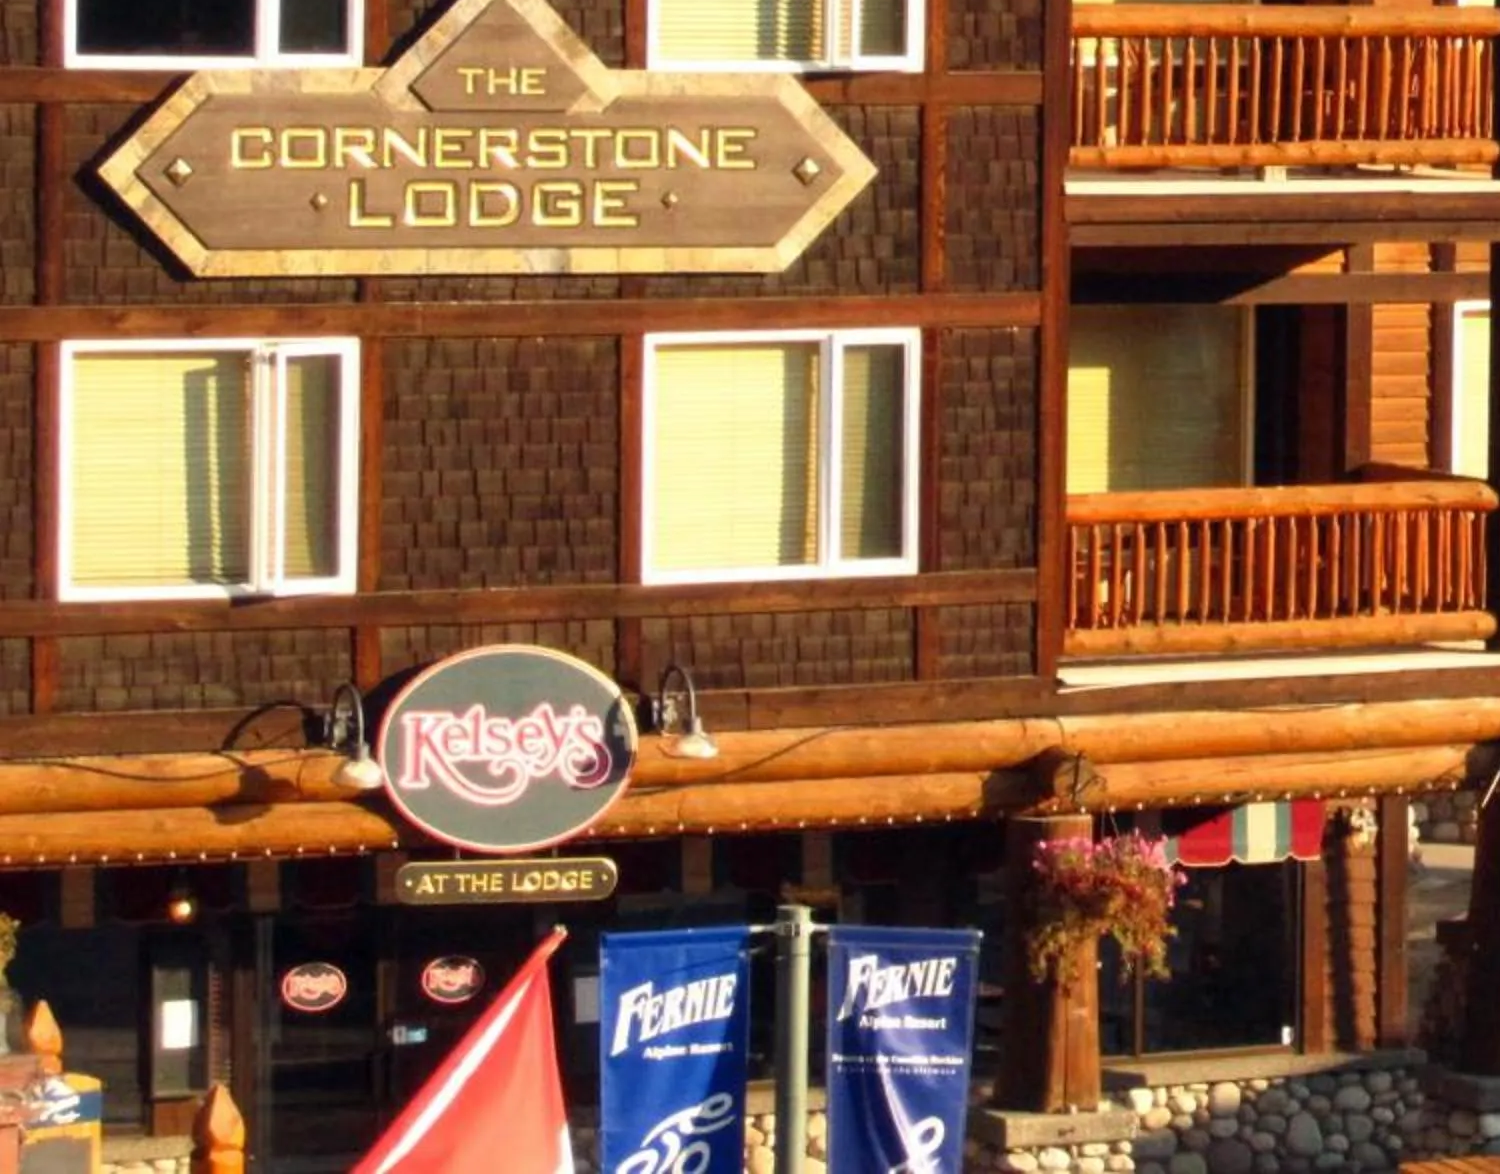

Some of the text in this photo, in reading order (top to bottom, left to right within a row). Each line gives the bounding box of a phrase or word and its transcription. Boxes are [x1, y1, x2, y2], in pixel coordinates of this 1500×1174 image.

[457, 67, 547, 95] THE
[231, 126, 757, 169] CORNERSTONE
[348, 179, 639, 228] LODGE
[399, 702, 612, 805] Kelsey's
[416, 870, 594, 895] AT THE LODGE
[836, 954, 957, 1022] FERNIE
[609, 972, 737, 1057] FERNIE
